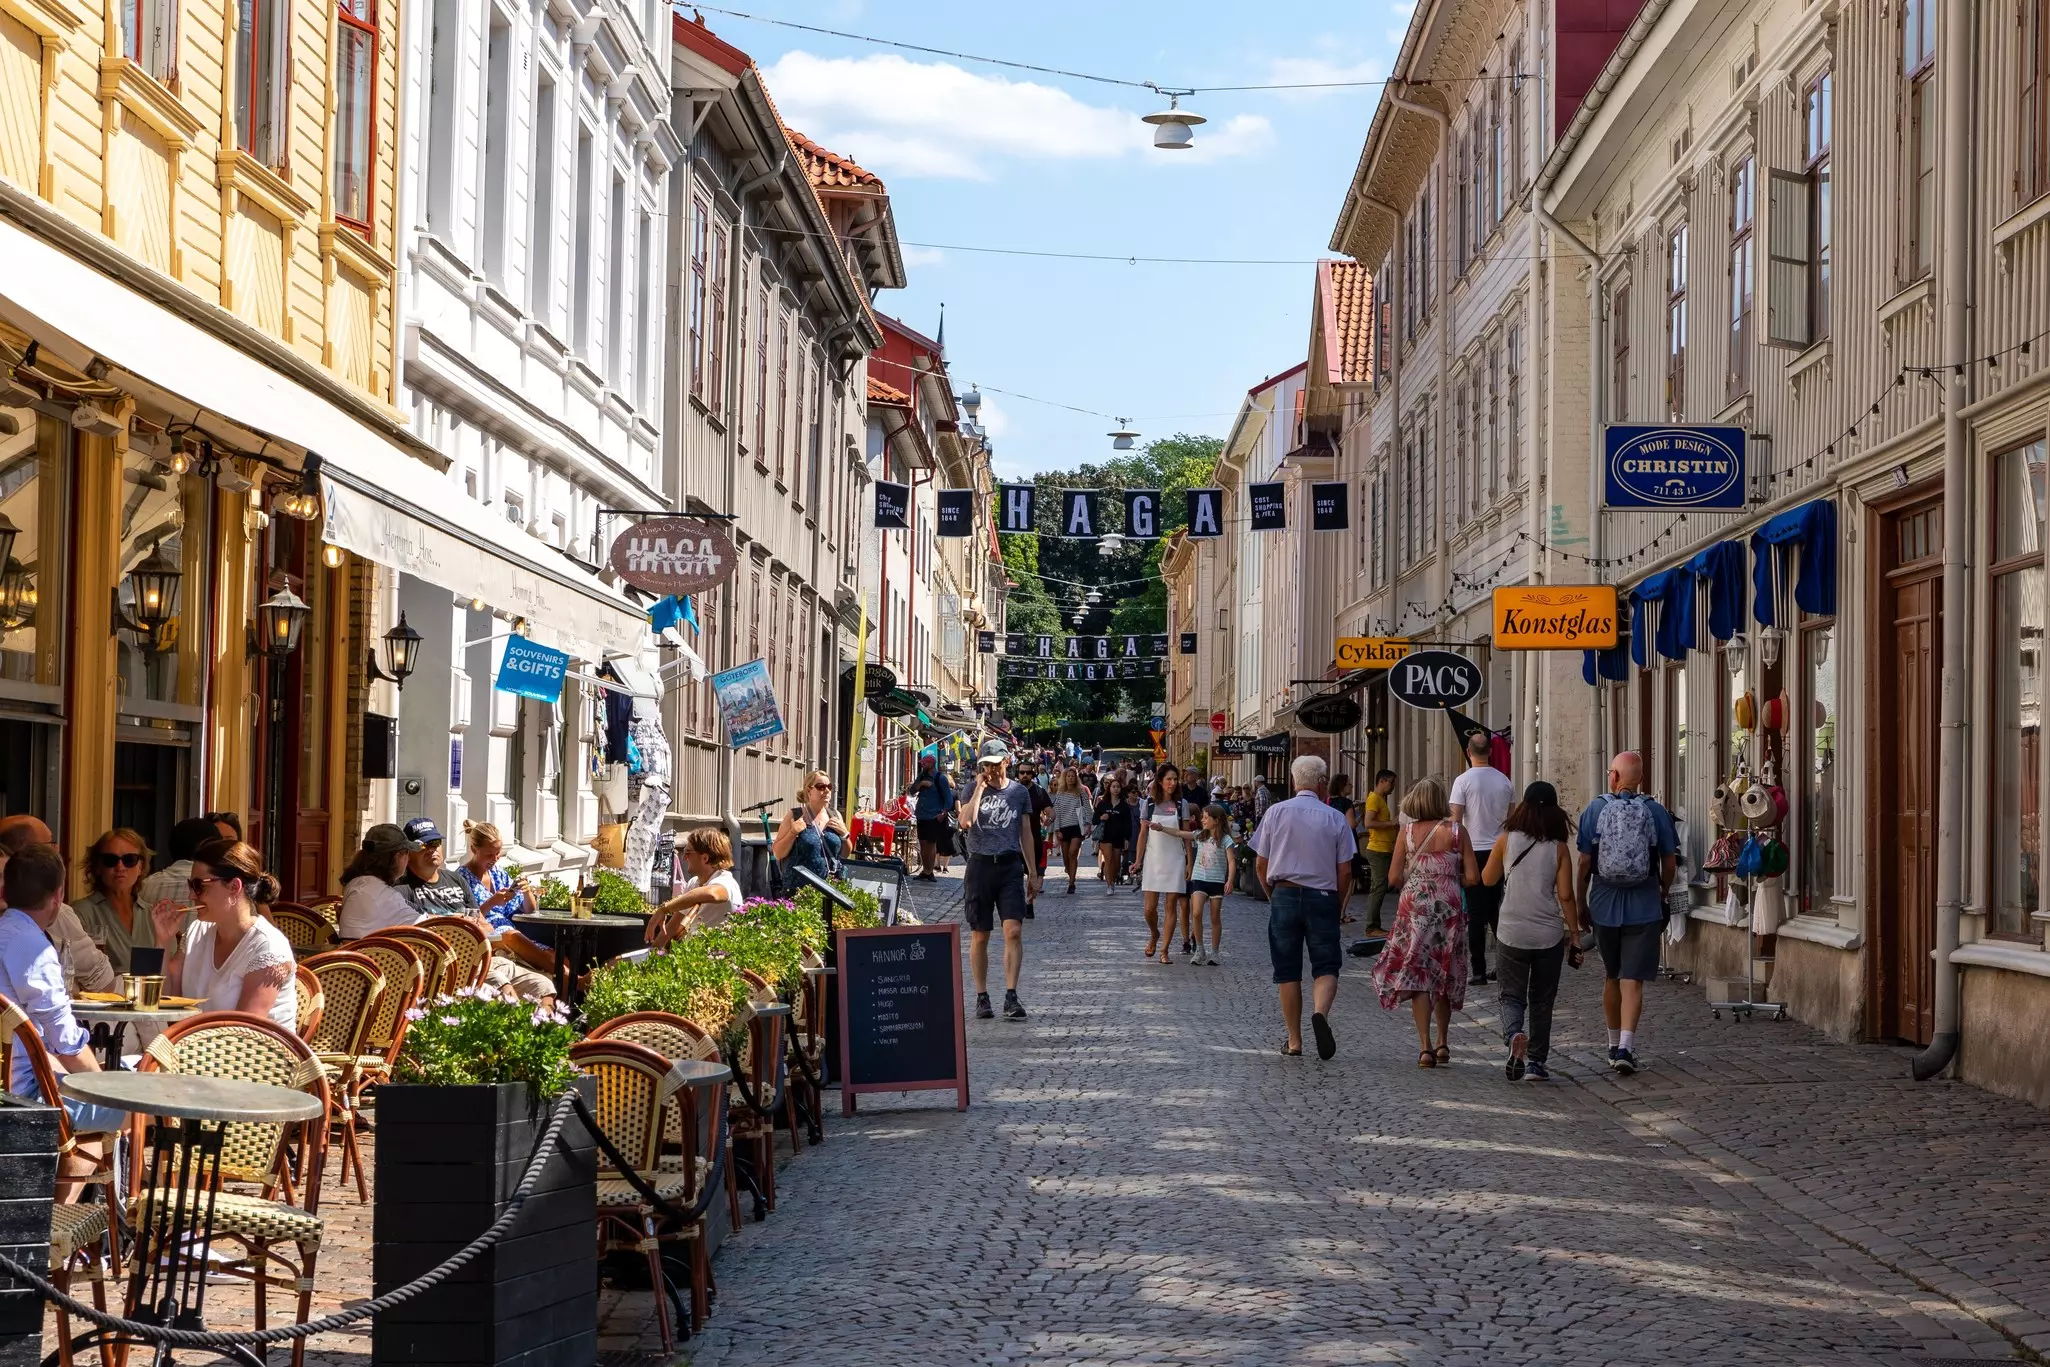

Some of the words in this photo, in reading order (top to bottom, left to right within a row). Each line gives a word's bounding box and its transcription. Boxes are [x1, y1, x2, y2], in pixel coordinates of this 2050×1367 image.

[1639, 439, 1670, 456] MODE
[1674, 439, 1713, 456] DESIGN
[1623, 459, 1728, 474] CHRISTIN
[1653, 486, 1669, 495] 711
[1672, 488, 1684, 496] 43
[1687, 486, 1697, 495] 11
[1254, 496, 1270, 504] COSY
[1254, 502, 1283, 512] SHOPPING
[1316, 499, 1335, 507] SINCE
[941, 514, 957, 522] 1848
[1007, 489, 1218, 536] HAGA
[637, 525, 662, 536] Haga
[662, 523, 676, 532] Of
[677, 524, 709, 538] Sweden
[625, 537, 722, 576] HAGA
[1500, 608, 1612, 640] Konstglas
[1039, 637, 1137, 658] HAGA
[1338, 643, 1407, 663] Cyklar
[509, 646, 564, 665] SOUVENIRS
[505, 657, 561, 679] &GIFTS
[720, 665, 759, 684] GÖTEBORG
[1048, 664, 1115, 679] HAGA
[1404, 664, 1470, 696] PACS
[1251, 744, 1285, 753] SJÖBAREN
[980, 795, 1008, 813] Blue
[988, 805, 1018, 829] Ridge
[872, 948, 907, 963] KANNOR
[877, 974, 911, 984] SANGRIA
[878, 986, 898, 996] MASSA
[899, 985, 918, 994] OLIKA
[877, 1000, 894, 1009] HUGO
[877, 1012, 899, 1021] MOJITO
